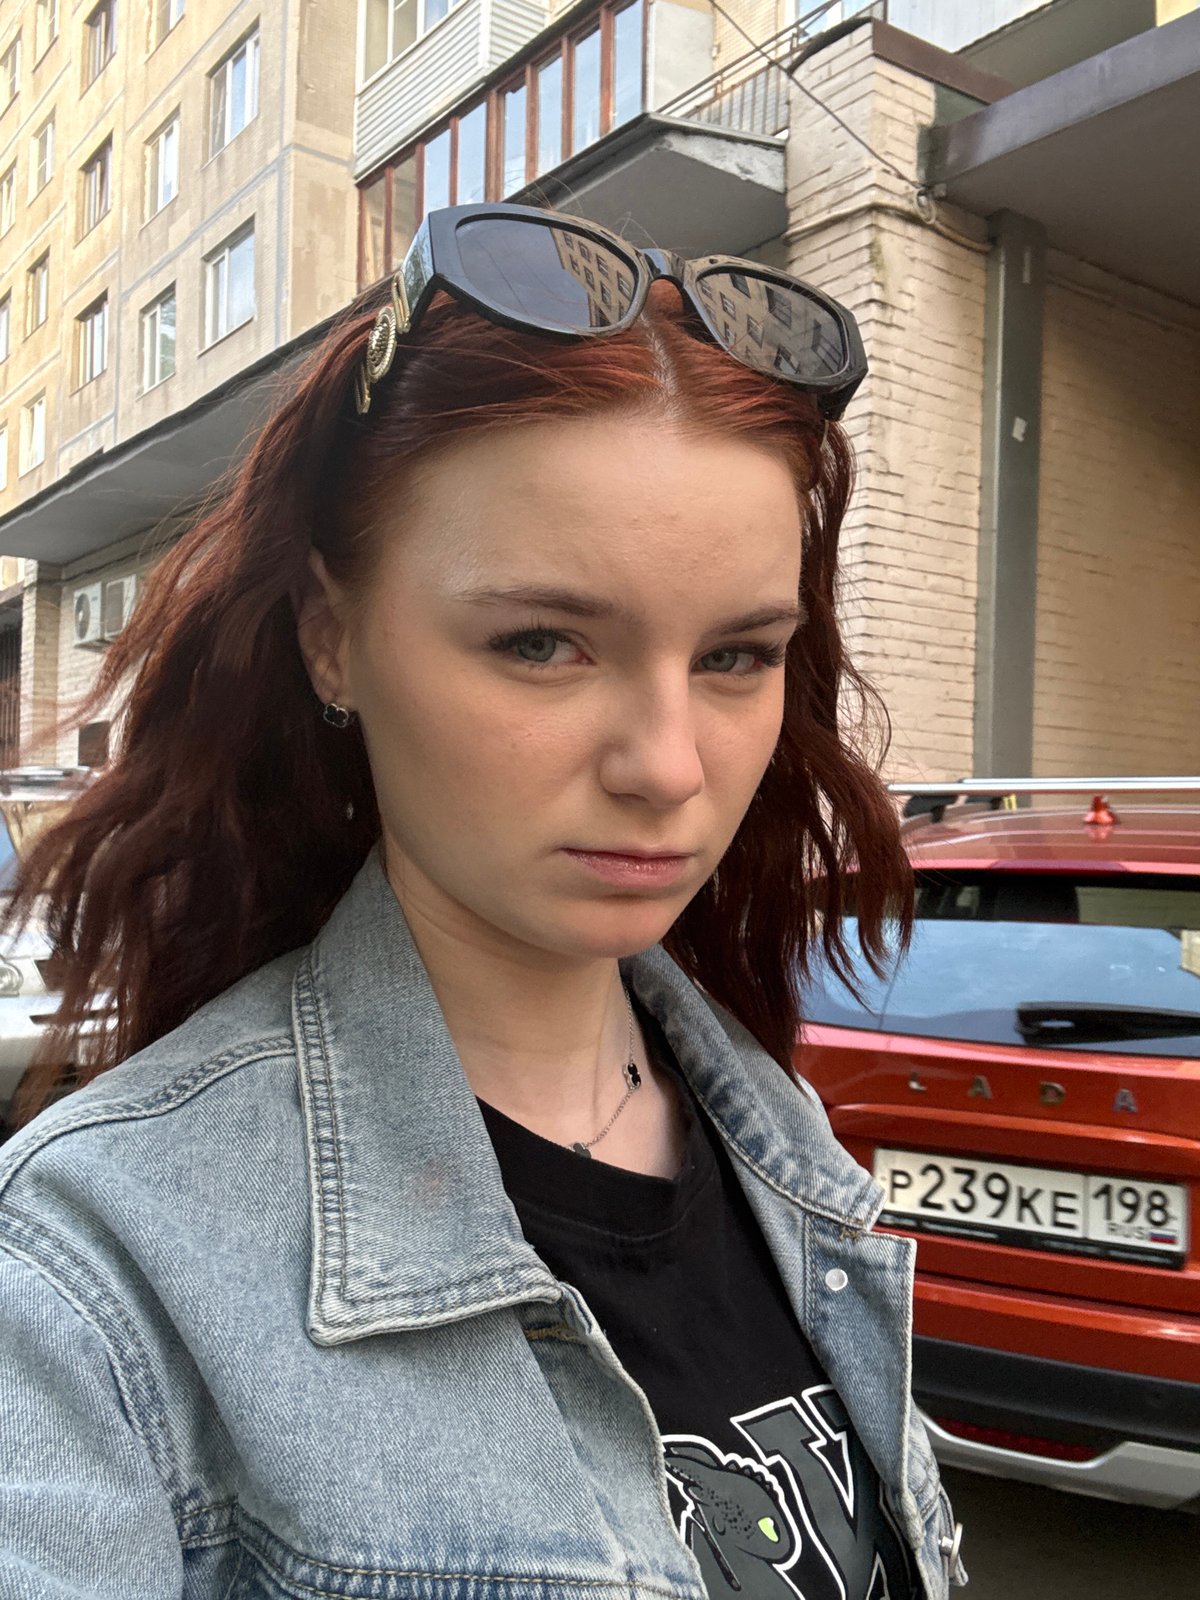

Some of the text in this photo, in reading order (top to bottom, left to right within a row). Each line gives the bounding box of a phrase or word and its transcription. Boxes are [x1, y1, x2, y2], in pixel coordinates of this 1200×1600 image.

[908, 1070, 1139, 1115] LADA
[1092, 1183, 1171, 1228] 198
[1106, 1221, 1150, 1241] RUS
